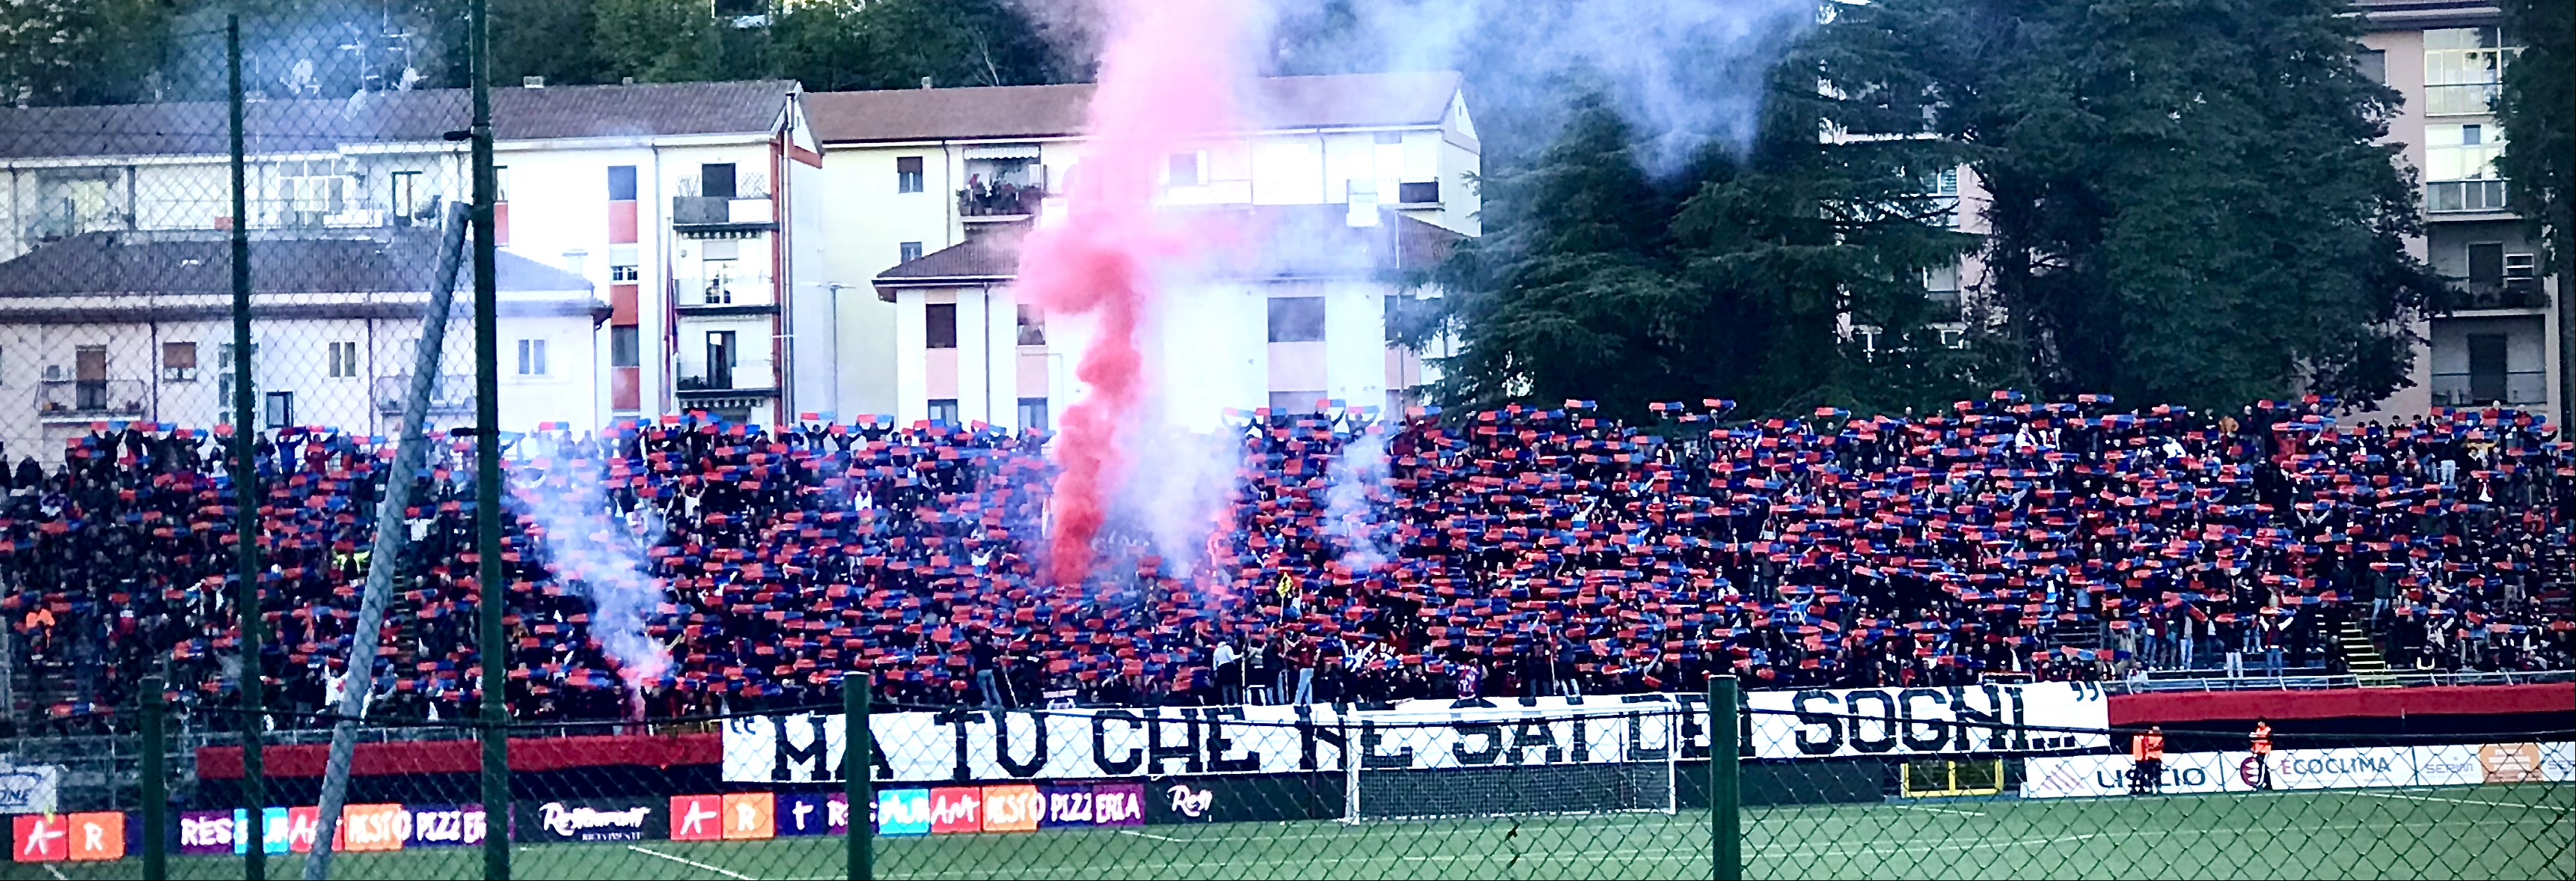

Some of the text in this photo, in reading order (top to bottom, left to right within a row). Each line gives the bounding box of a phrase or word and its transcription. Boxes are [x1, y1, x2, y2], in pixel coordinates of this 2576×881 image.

[933, 706, 1047, 784] TU
[1092, 708, 1260, 775] CHE
[1293, 702, 1413, 772] NE
[1449, 696, 1589, 764] SAI
[2281, 757, 2392, 775] ECOCLIMA
[1050, 792, 1141, 823] PIZZERIA
[416, 810, 486, 844] PIZZER
